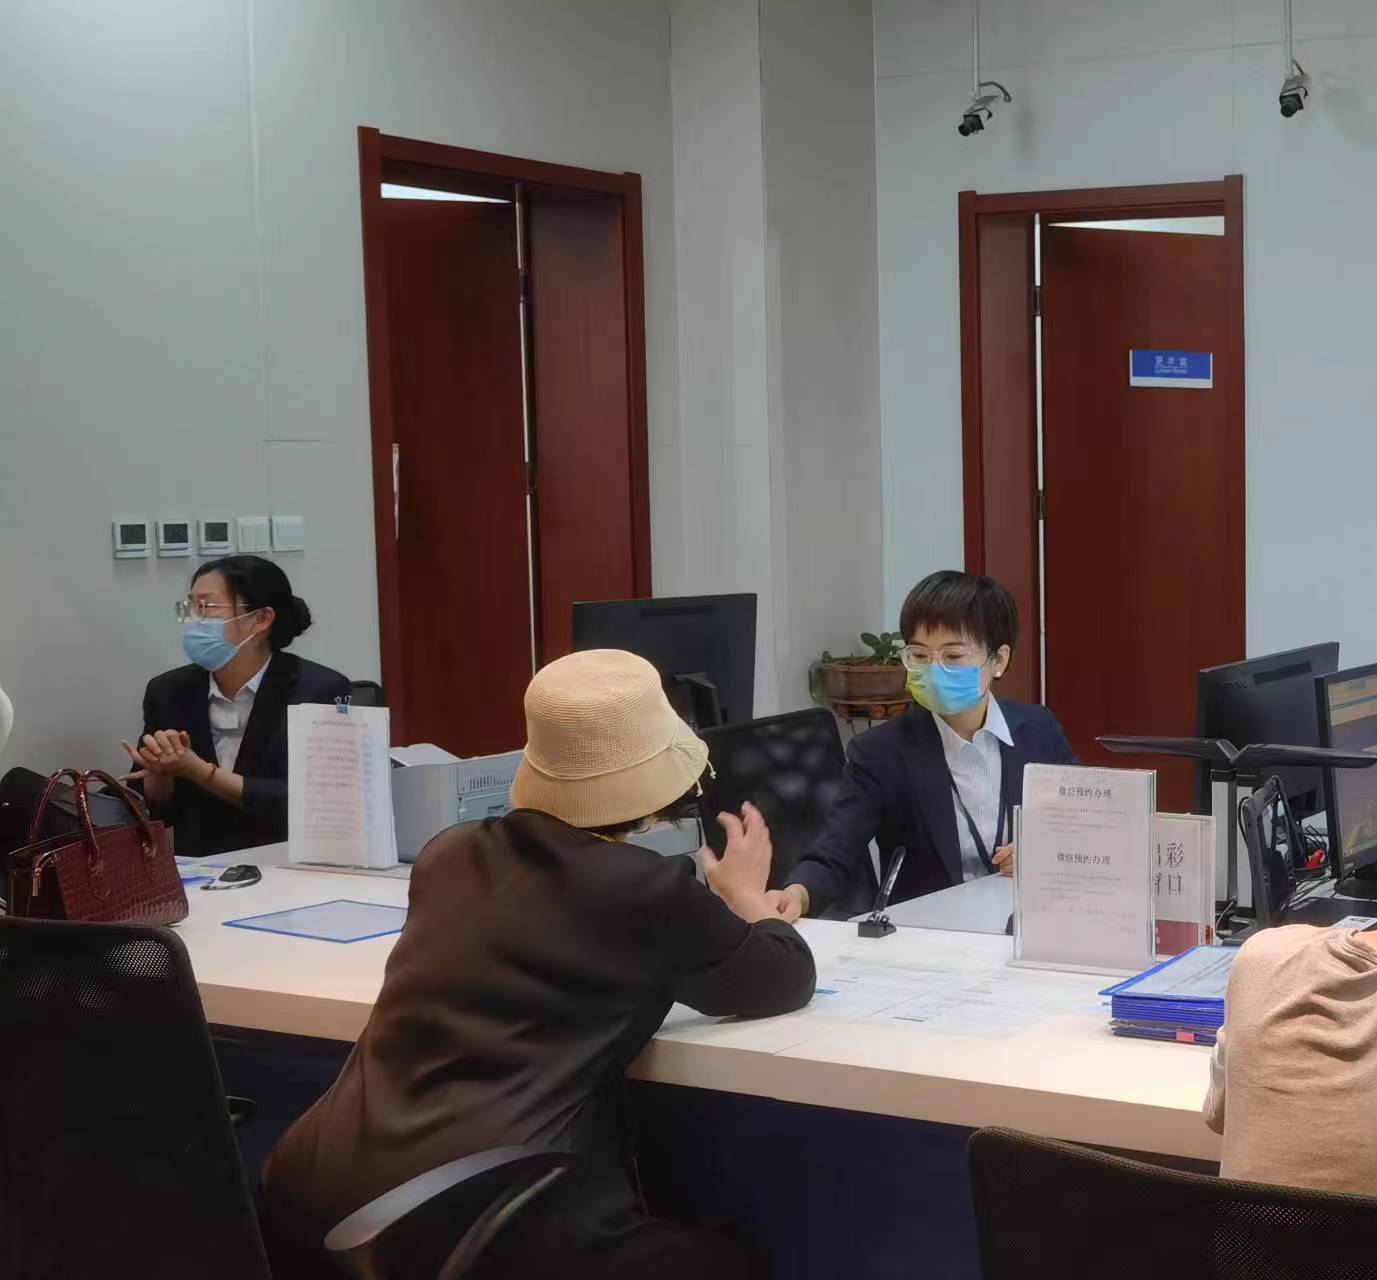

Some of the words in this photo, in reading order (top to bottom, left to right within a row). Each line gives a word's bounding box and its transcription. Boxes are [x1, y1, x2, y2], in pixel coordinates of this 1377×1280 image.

[1058, 786, 1112, 799] 微信预约办理
[1057, 852, 1111, 865] 微信预约办理
